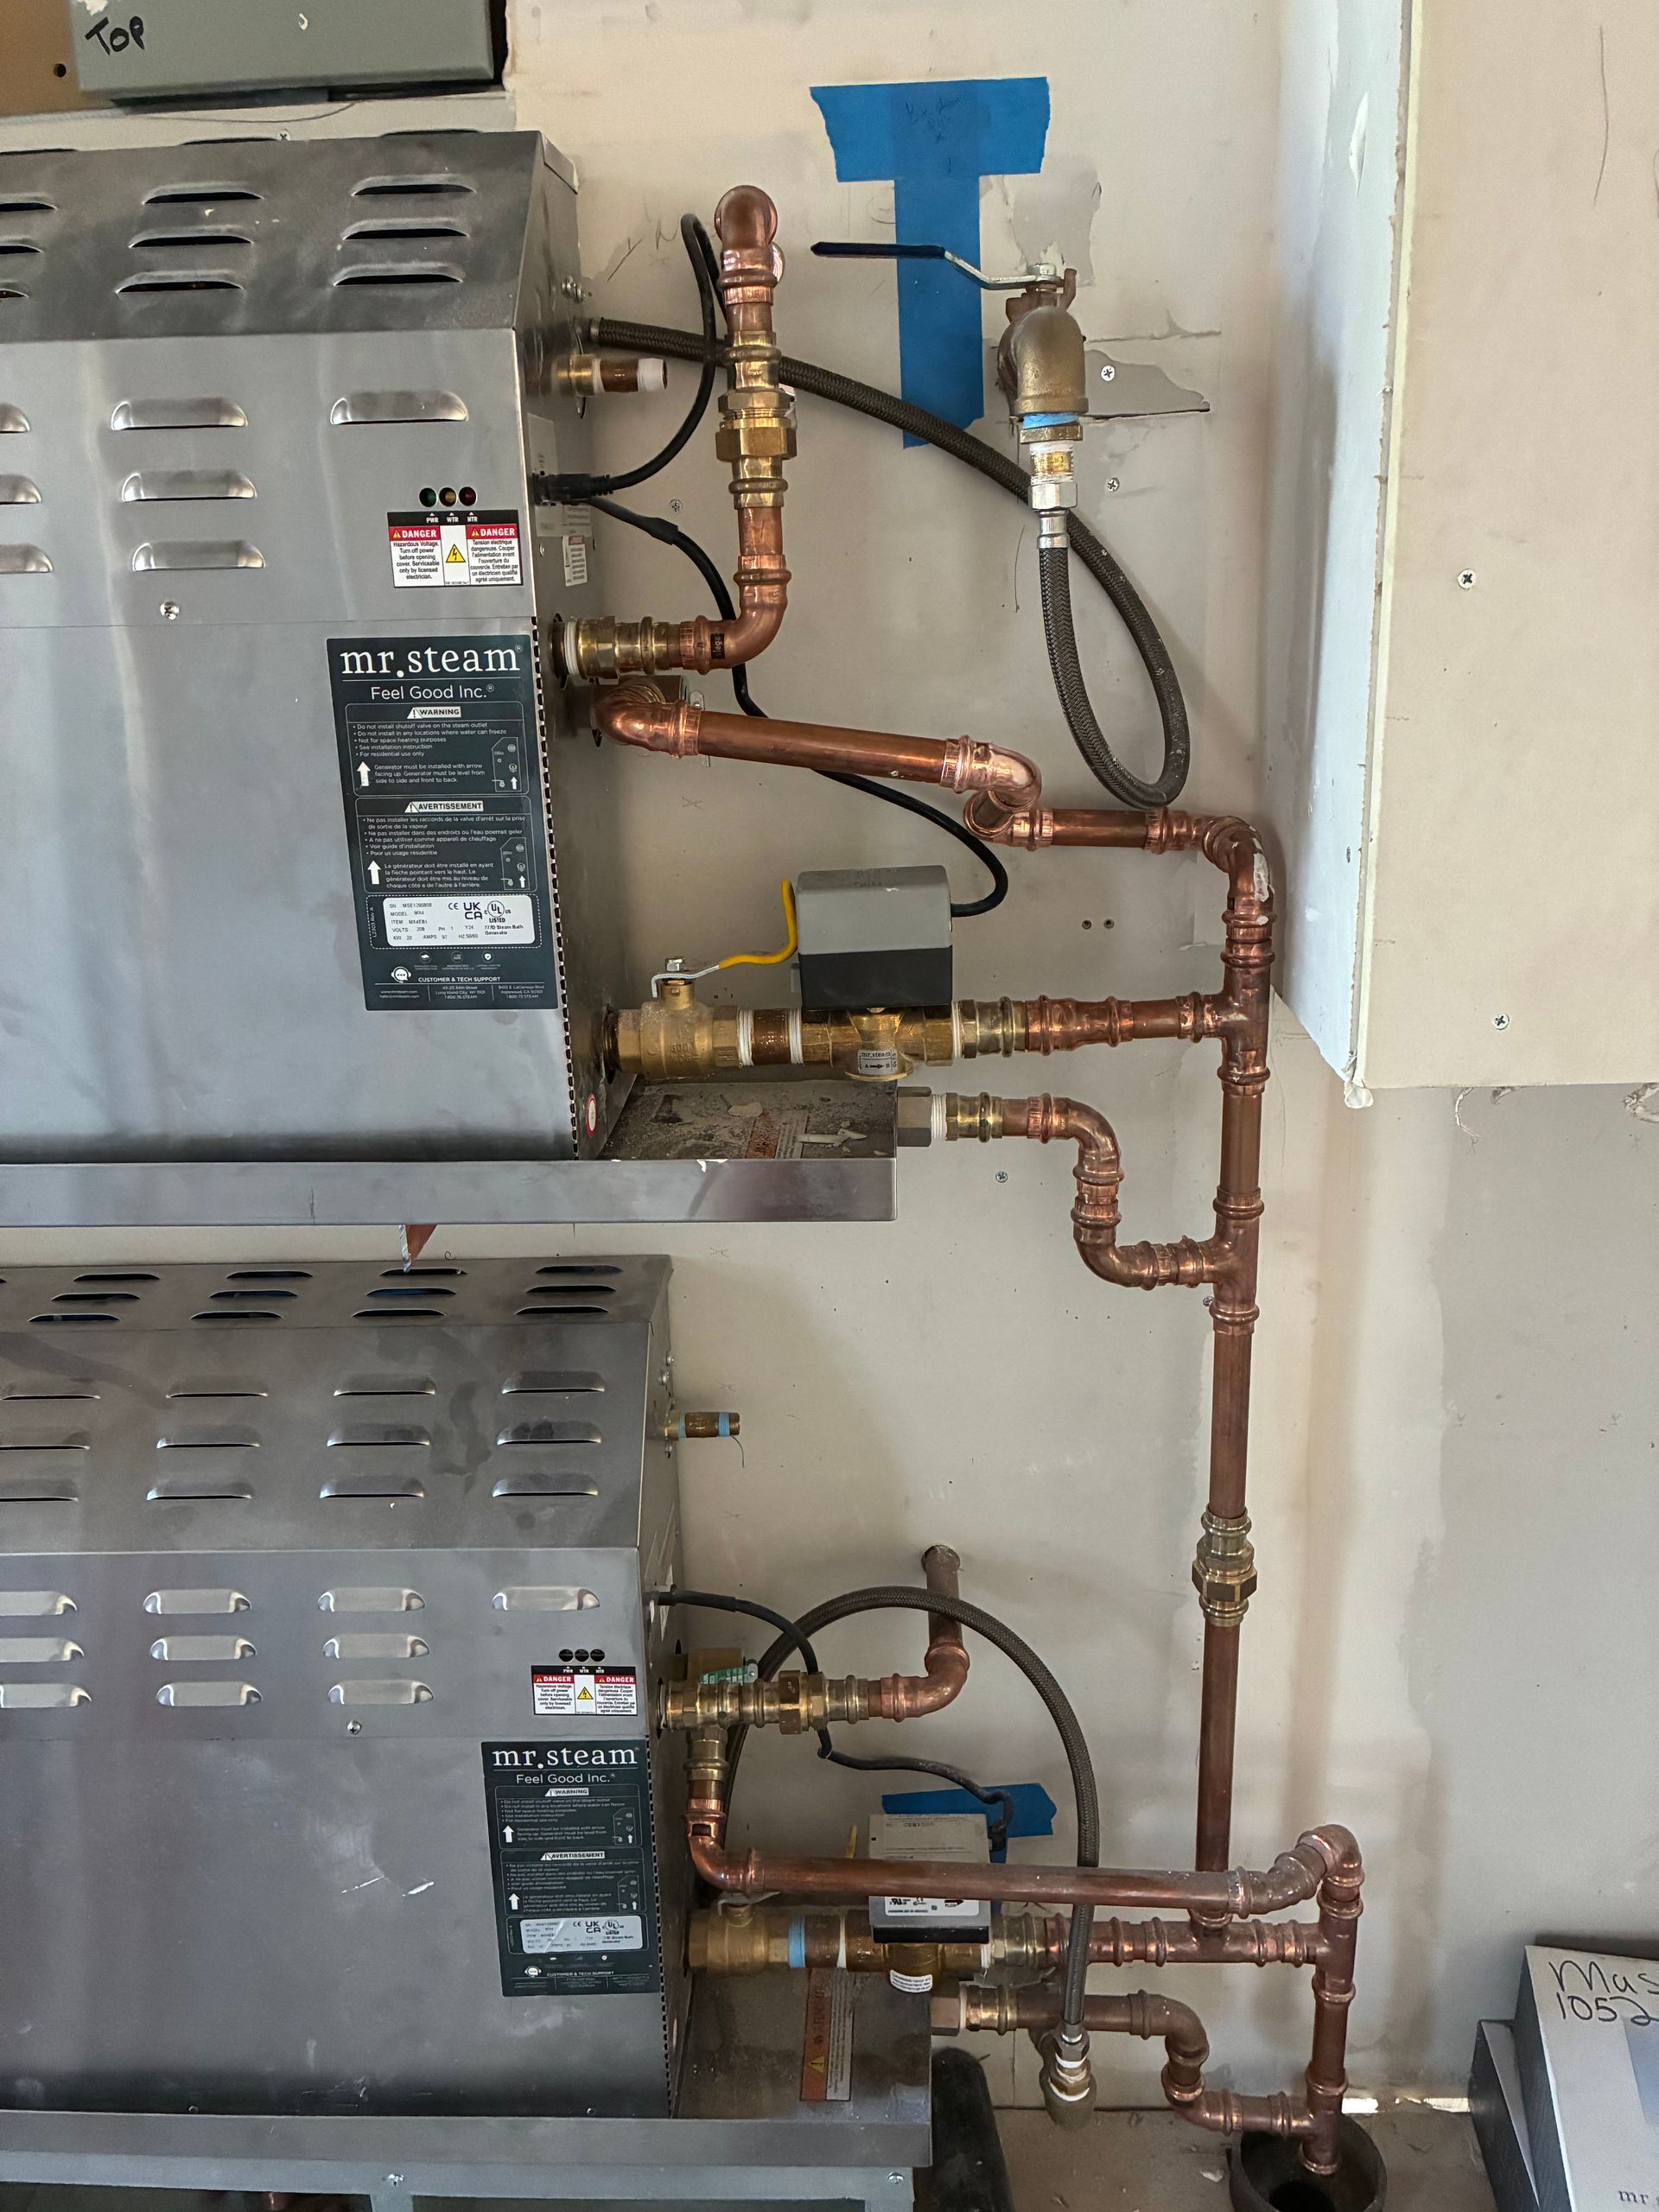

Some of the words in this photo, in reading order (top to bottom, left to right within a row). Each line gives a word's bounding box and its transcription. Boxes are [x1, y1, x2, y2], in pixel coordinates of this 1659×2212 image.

[85, 16, 145, 55] TOP
[402, 530, 436, 538] DANGER
[371, 686, 404, 700] Feel
[410, 685, 454, 699] Good
[463, 902, 480, 911] UK
[491, 904, 501, 914] UL
[516, 1774, 543, 1783] Feel
[548, 1774, 583, 1783] Good
[1556, 1992, 1659, 2026] 1052
